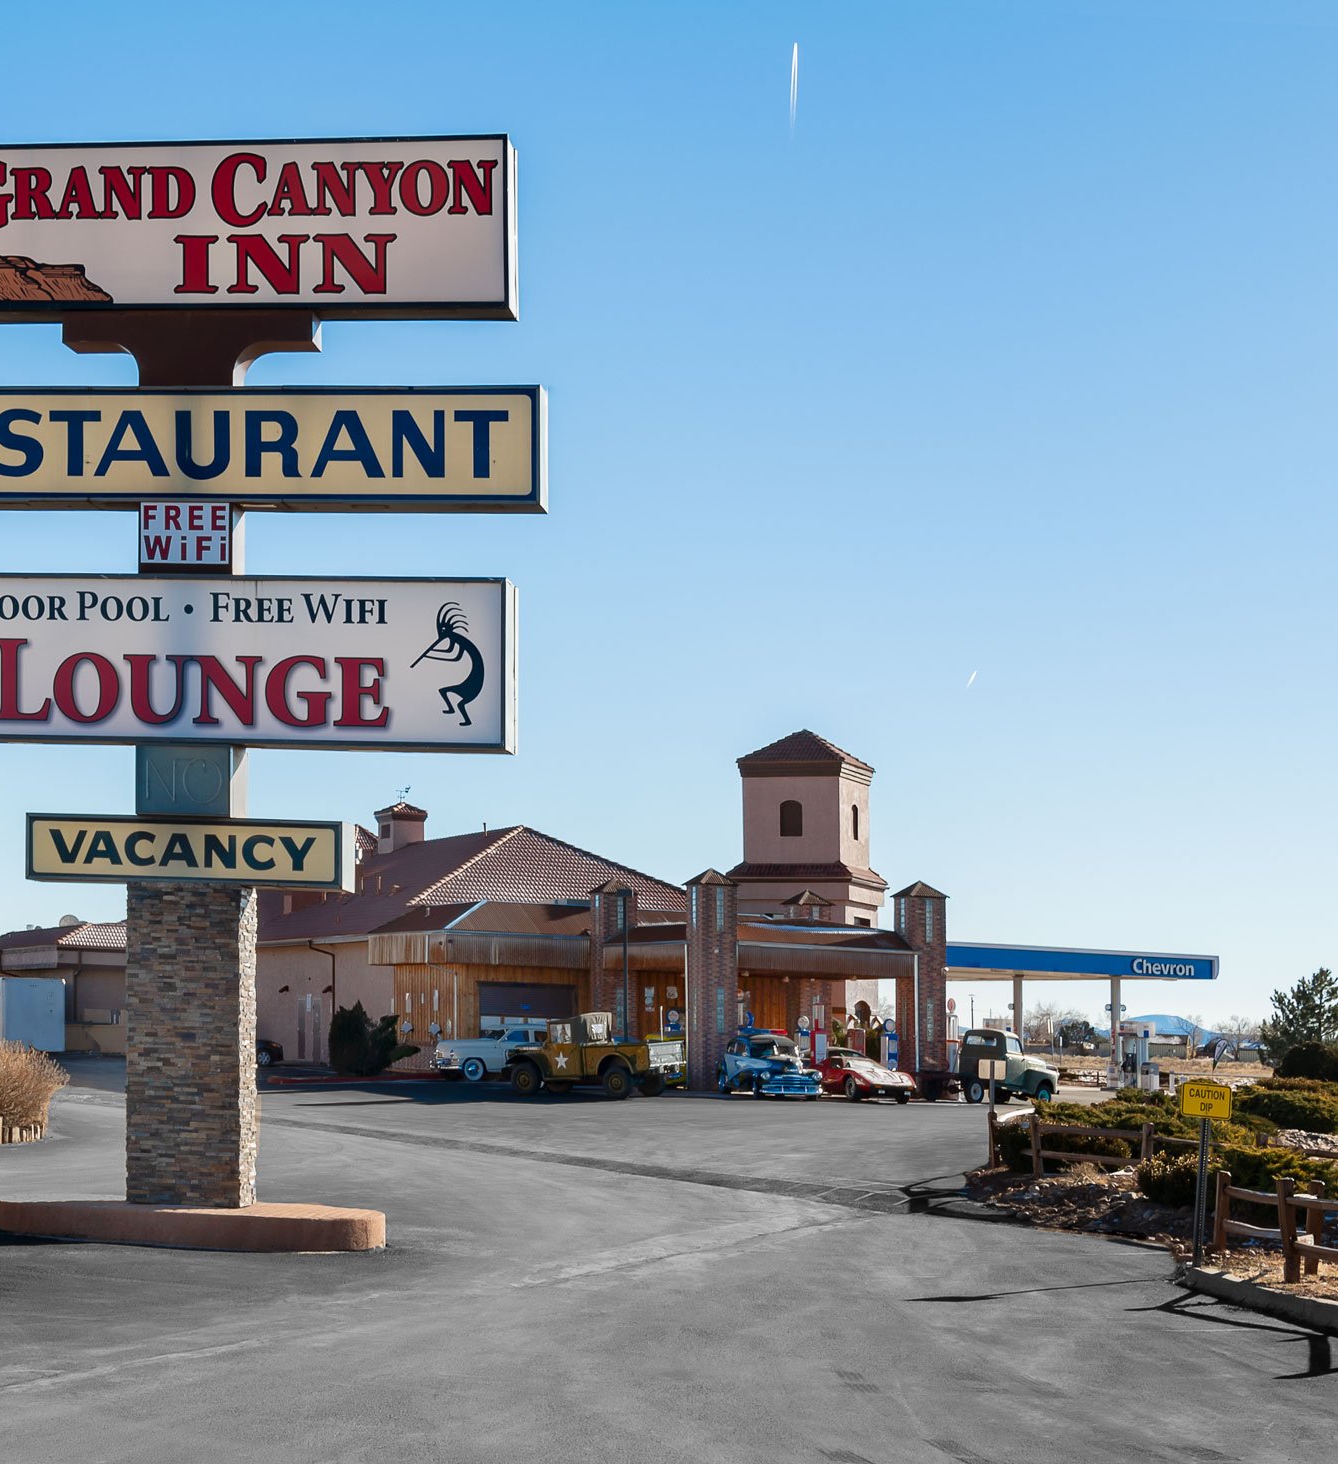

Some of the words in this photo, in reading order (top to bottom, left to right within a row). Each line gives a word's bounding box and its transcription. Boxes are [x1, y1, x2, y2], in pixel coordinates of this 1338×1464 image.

[211, 152, 499, 228] CANYON
[173, 232, 397, 296] INN
[143, 505, 228, 532] FREE
[143, 535, 229, 563] WiFi
[76, 590, 170, 622] POOL
[209, 591, 294, 624] FREE
[299, 593, 389, 625] WIFI
[145, 758, 222, 804] NO
[48, 828, 317, 873] VACANCY
[1132, 958, 1195, 977] Chevron
[1189, 1088, 1225, 1101] CAUTION
[1199, 1102, 1213, 1112] DIP
